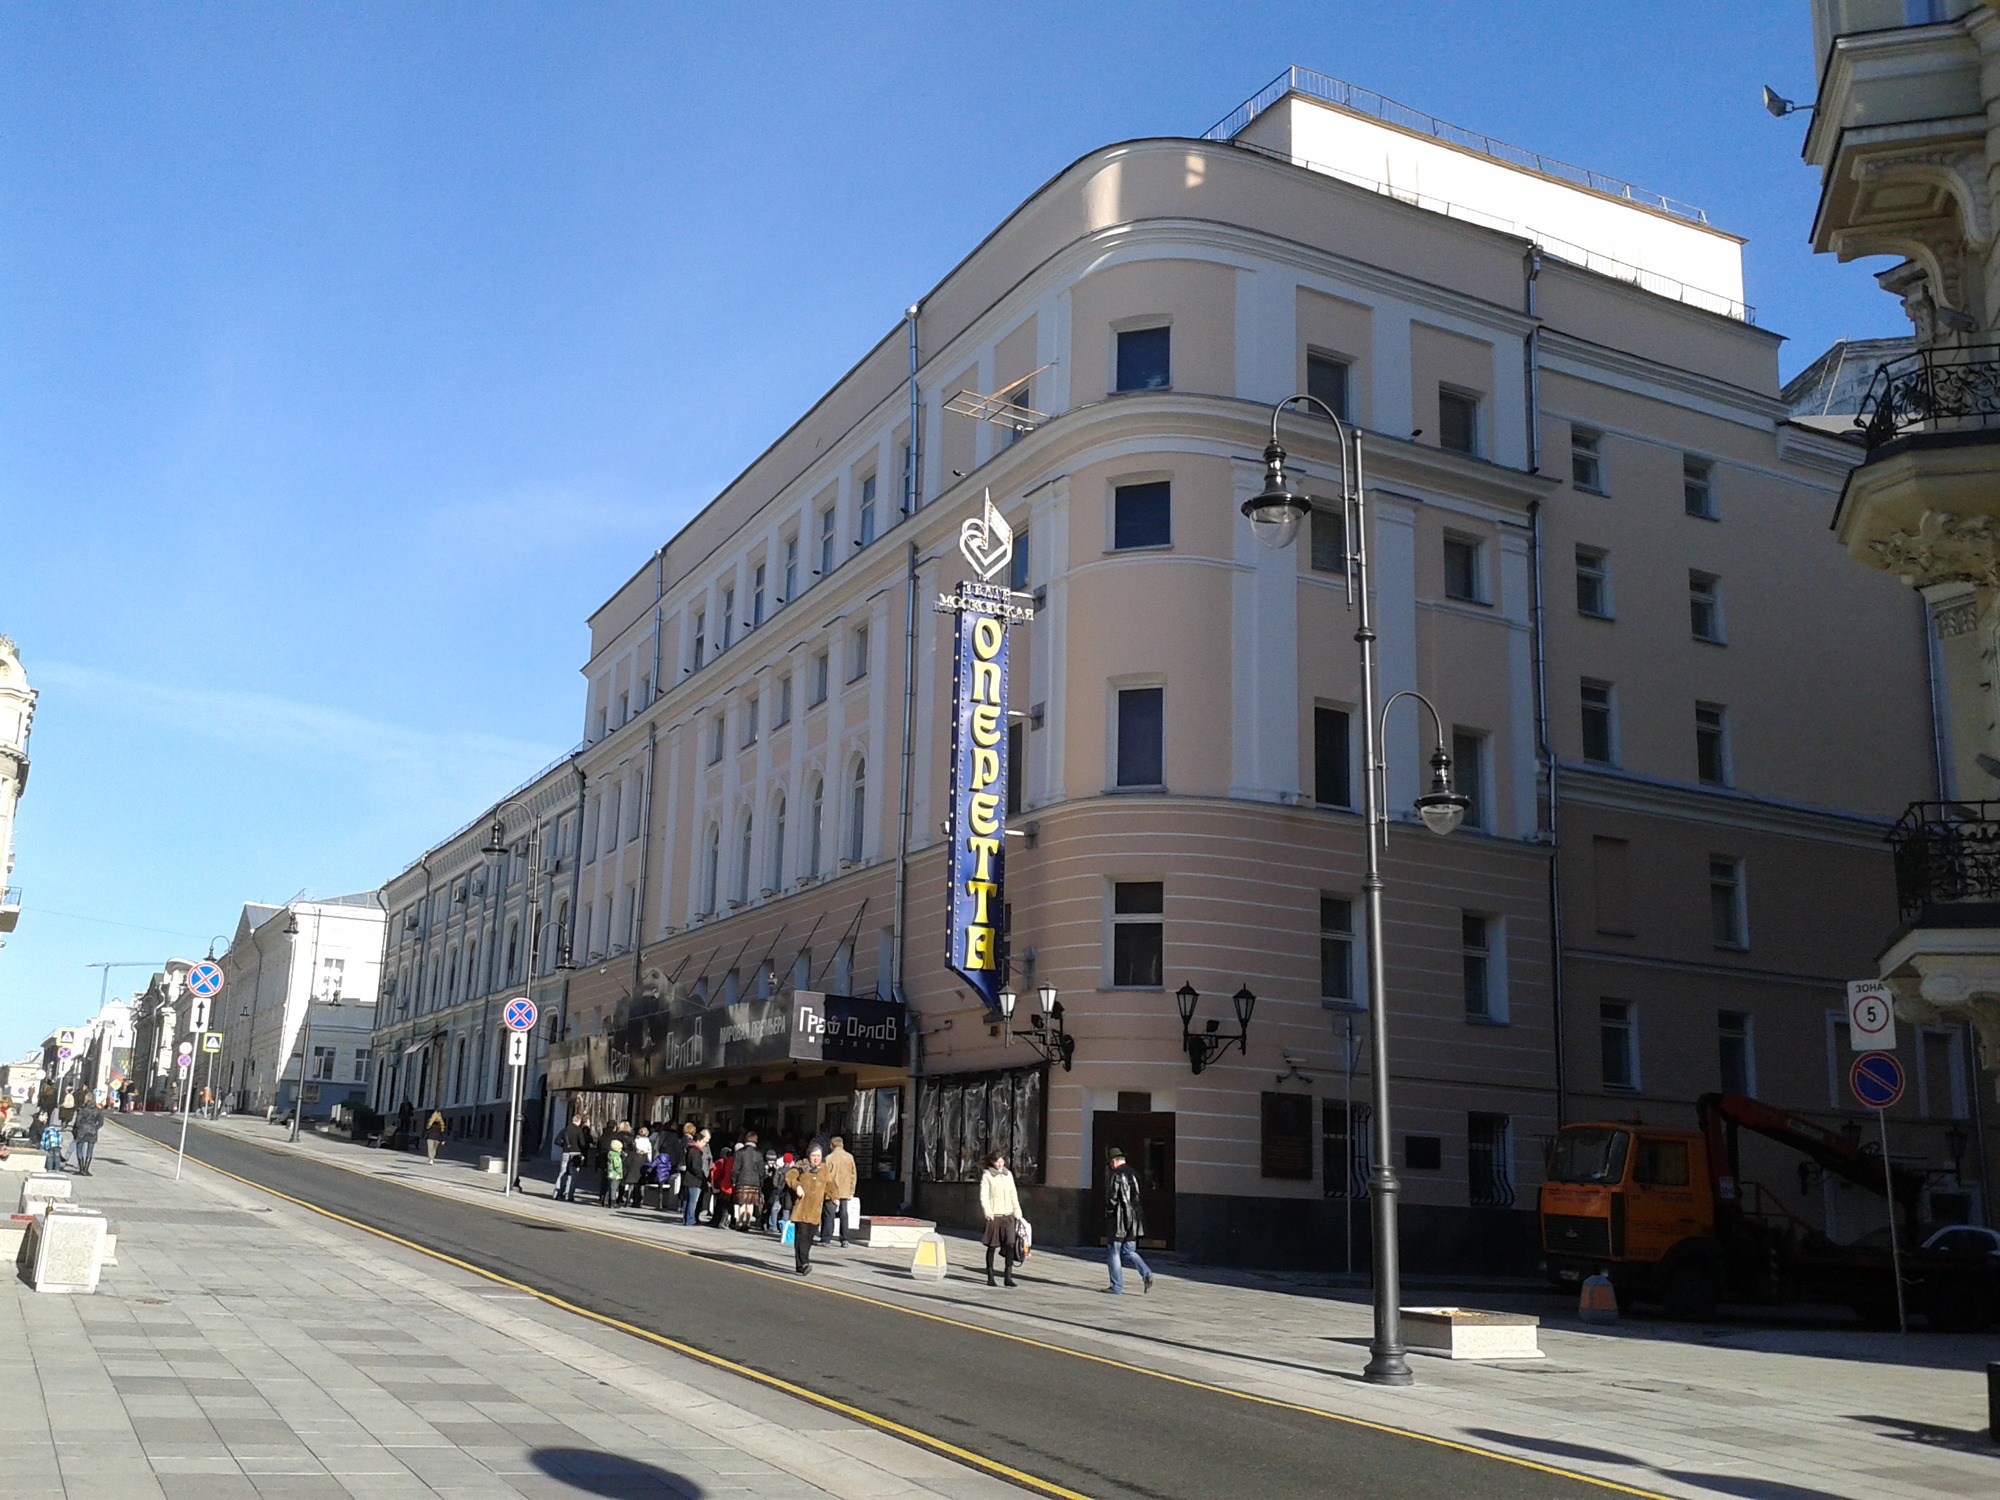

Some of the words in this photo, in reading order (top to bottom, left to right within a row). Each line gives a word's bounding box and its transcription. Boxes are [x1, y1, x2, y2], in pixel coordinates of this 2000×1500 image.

[939, 593, 1034, 621] МОСКОВСКАЯ
[965, 617, 1002, 971] ОПЕРЕТТА
[1855, 983, 1884, 993] ЗОНА
[1867, 1006, 1876, 1022] 5
